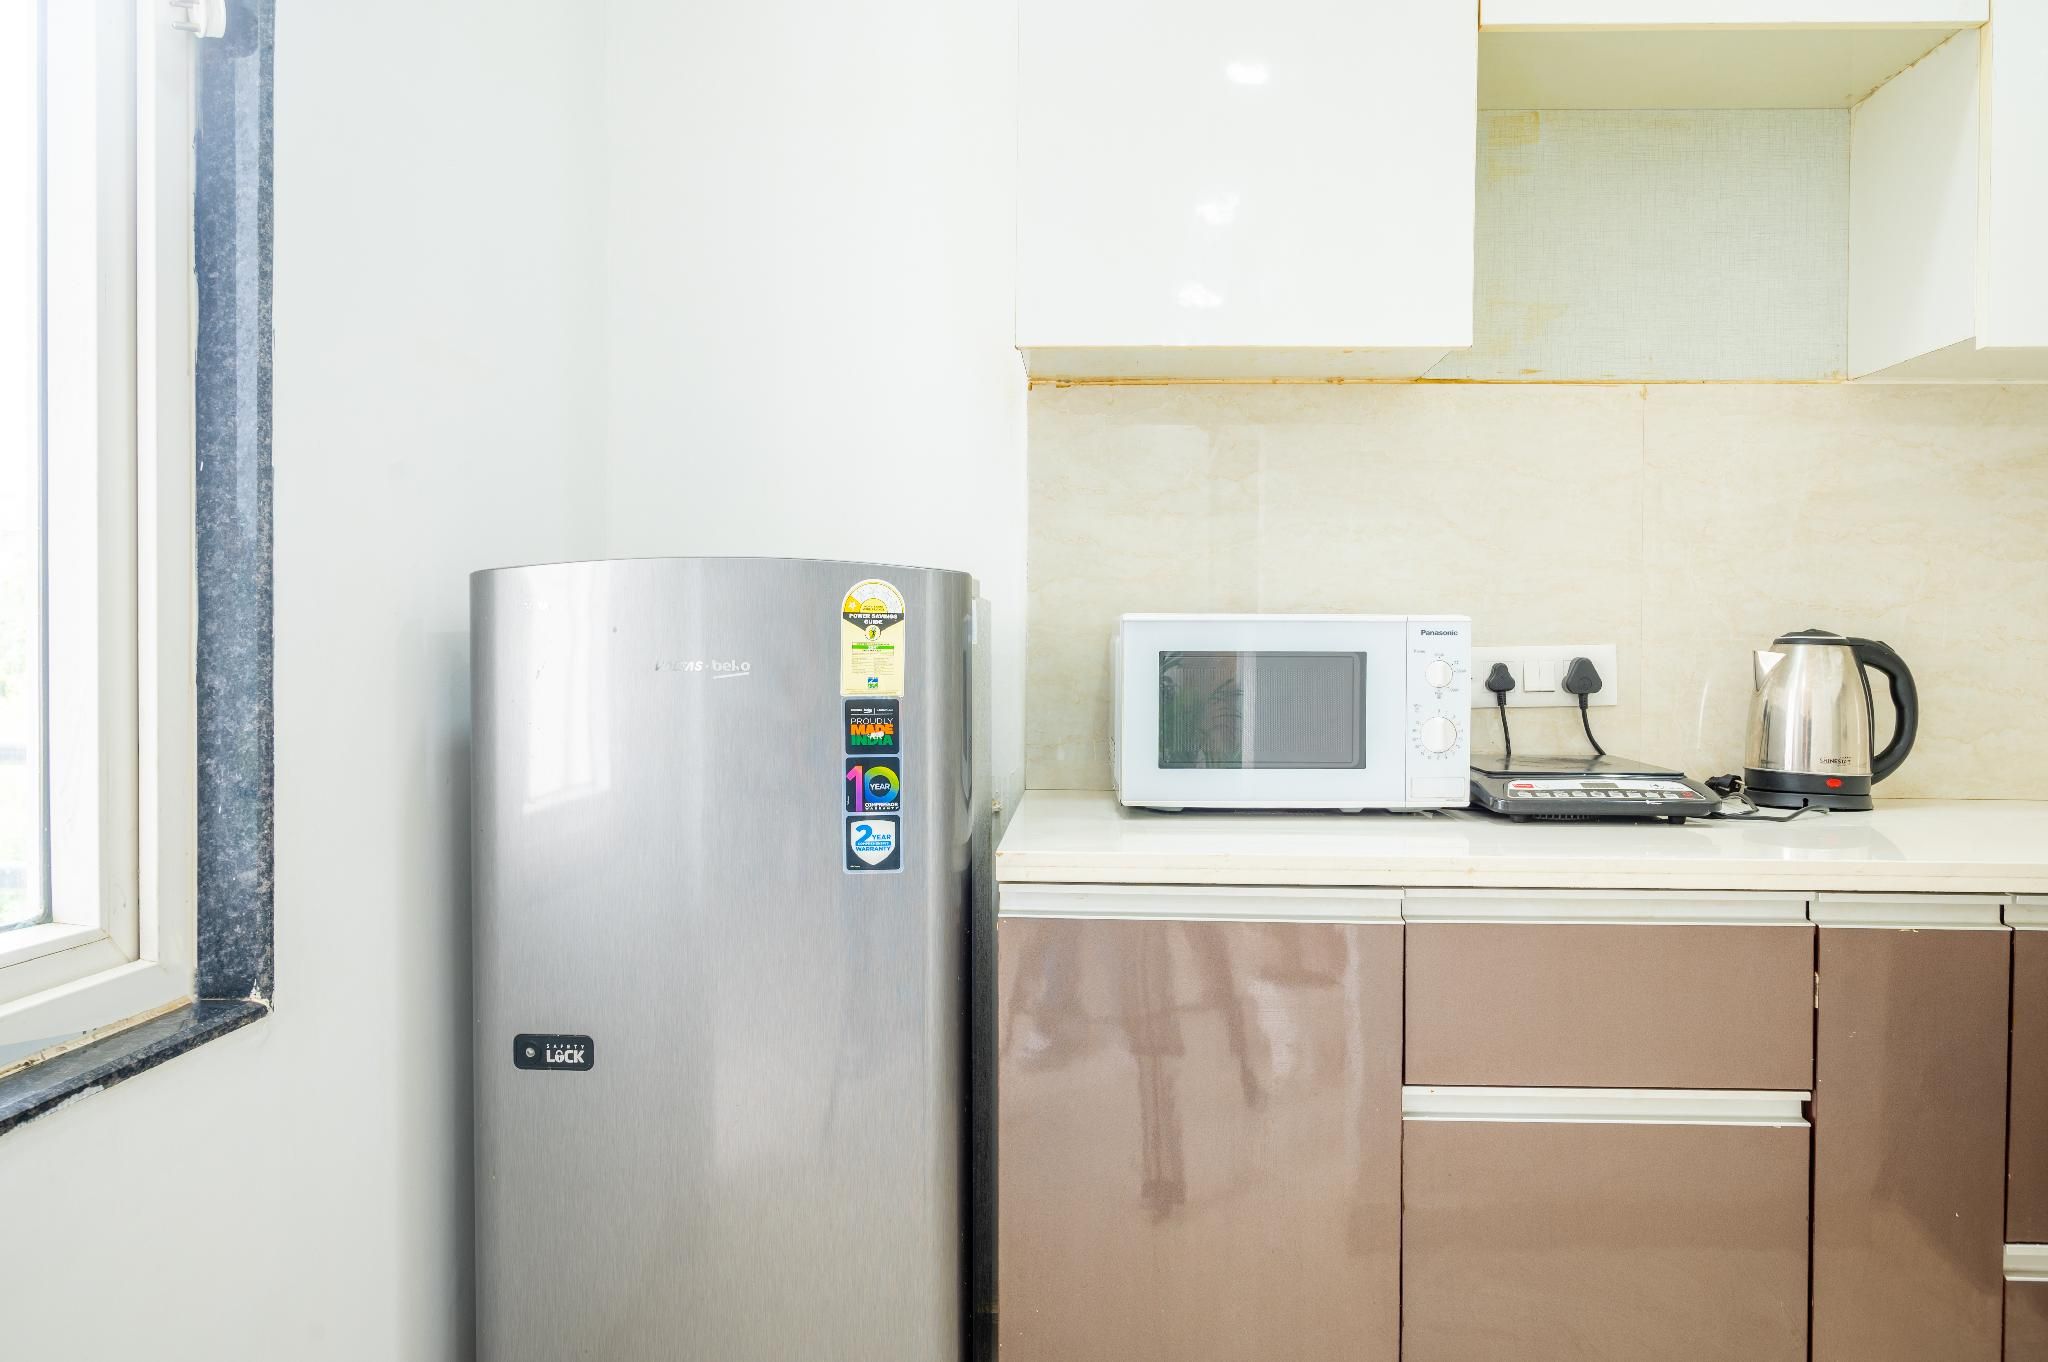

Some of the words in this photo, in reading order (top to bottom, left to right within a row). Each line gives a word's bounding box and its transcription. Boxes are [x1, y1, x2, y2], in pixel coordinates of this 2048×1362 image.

[711, 659, 751, 672] beko
[850, 724, 894, 735] MADE
[851, 735, 894, 746] INDIA
[846, 765, 900, 812] 10
[855, 824, 873, 846] 2
[546, 1050, 585, 1063] LOCK
